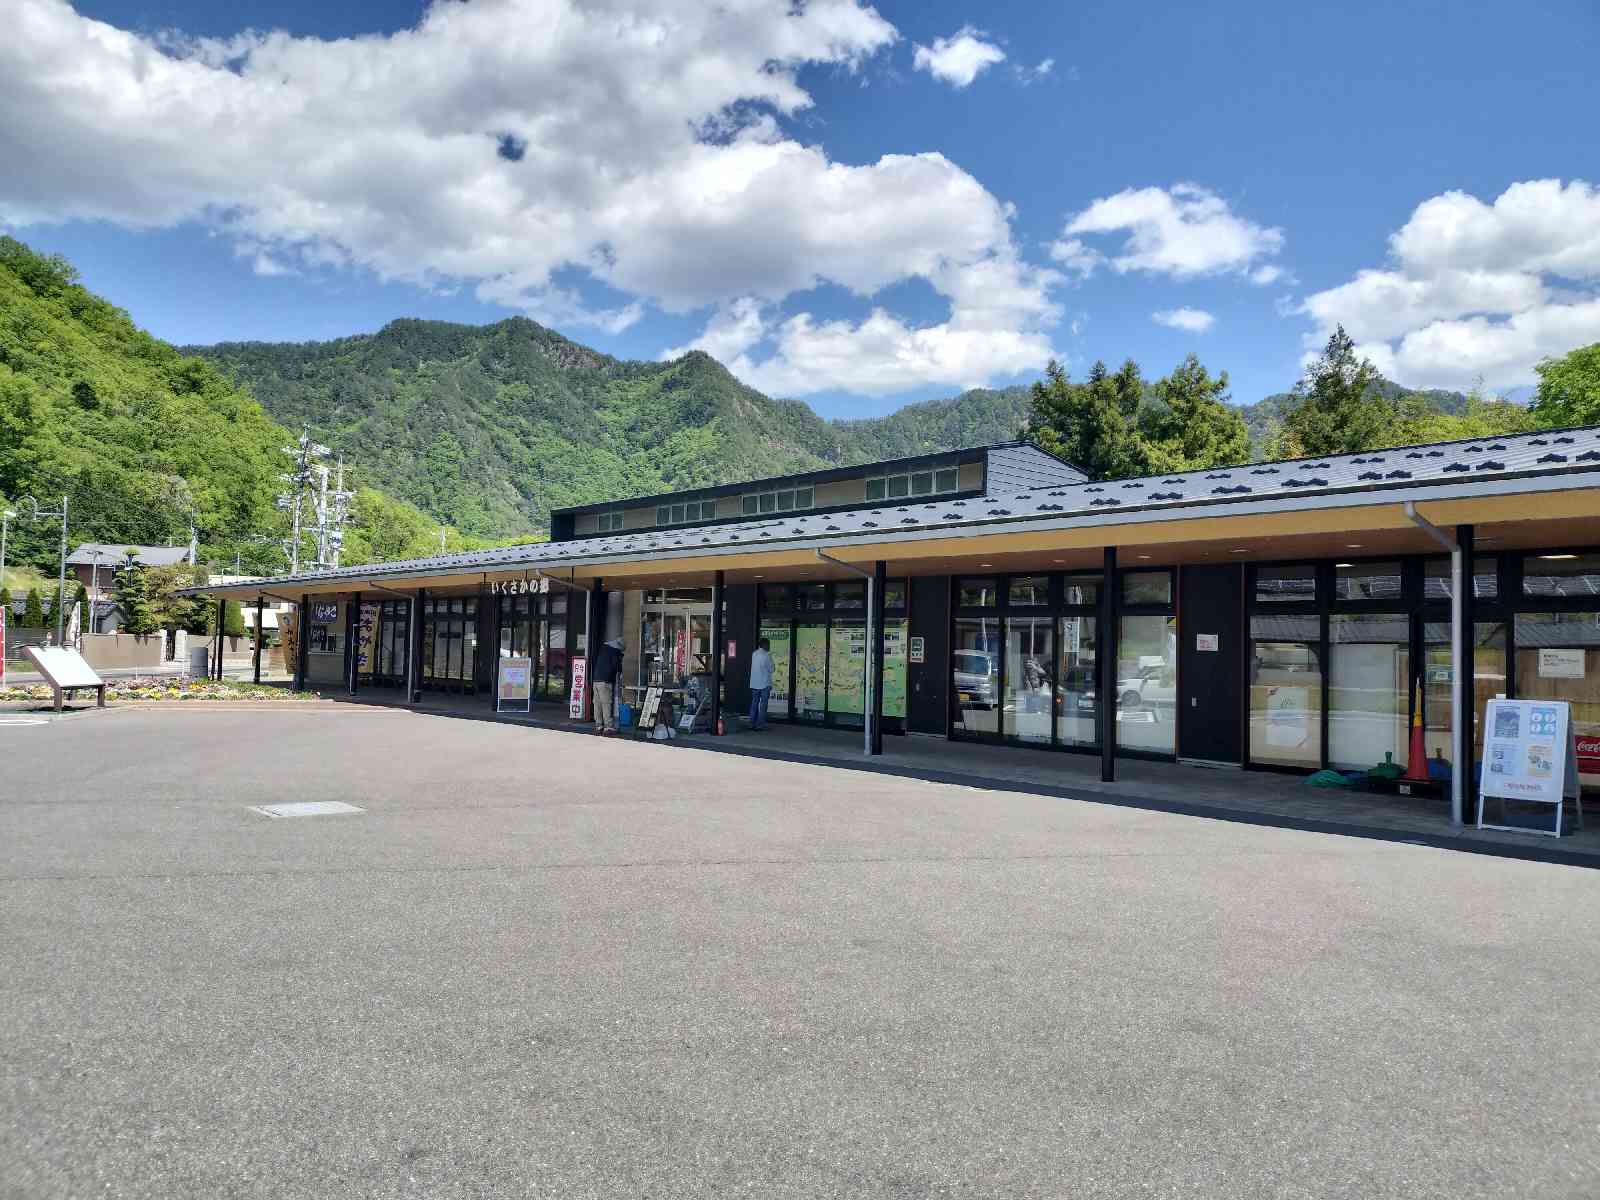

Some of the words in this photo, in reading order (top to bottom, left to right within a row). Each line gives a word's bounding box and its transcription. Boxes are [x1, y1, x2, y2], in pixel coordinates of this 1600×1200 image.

[491, 577, 549, 596] いくさかの郷
